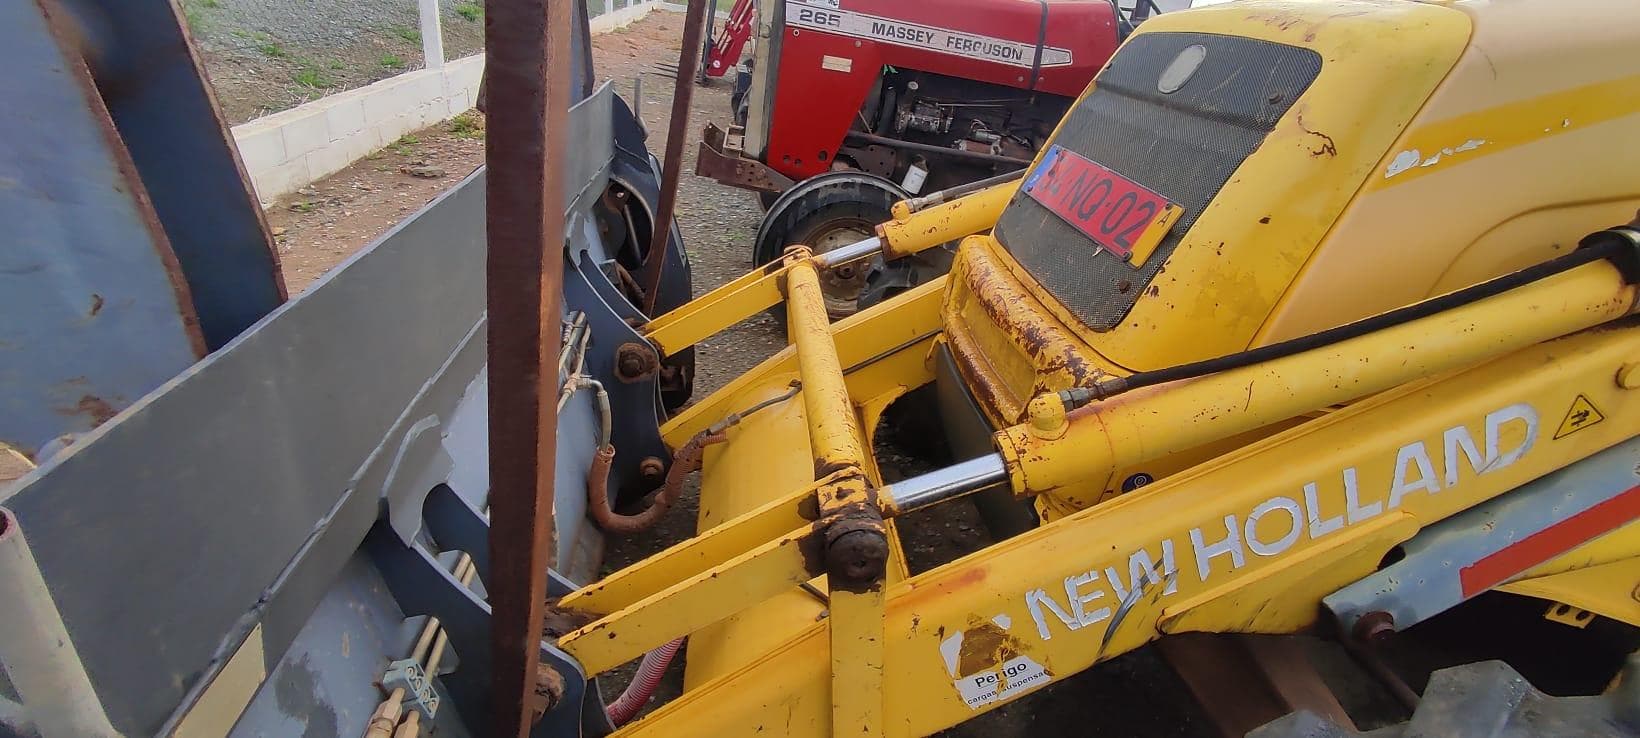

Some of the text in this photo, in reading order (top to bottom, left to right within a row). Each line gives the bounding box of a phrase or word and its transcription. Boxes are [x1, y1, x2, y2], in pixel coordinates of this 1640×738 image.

[800, 9, 841, 27] 265
[871, 22, 1023, 60] MASSEY FERGUSON
[1025, 402, 1540, 640] NEW HOLLAND
[1003, 669, 1049, 692] uspensa
